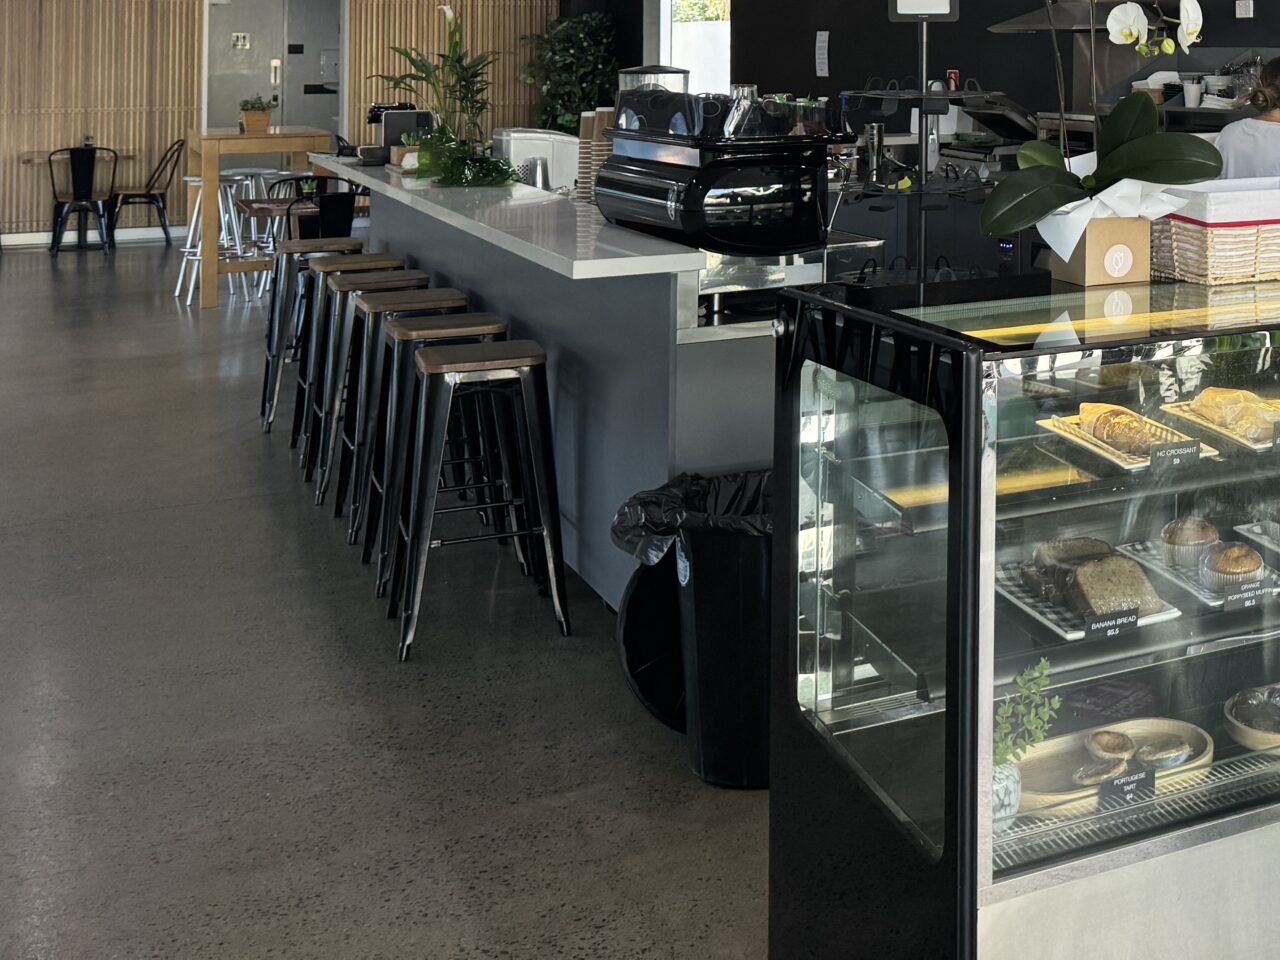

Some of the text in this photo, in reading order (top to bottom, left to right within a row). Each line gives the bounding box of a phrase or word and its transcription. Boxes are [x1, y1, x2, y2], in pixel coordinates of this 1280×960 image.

[1167, 447, 1197, 457] CROISSANT
[1241, 582, 1260, 591] ORANGE
[1227, 588, 1274, 601] POPPYSEED MUFFIN
[1091, 615, 1137, 630] BANANA BREAD
[1113, 771, 1146, 786] PORTUGESE
